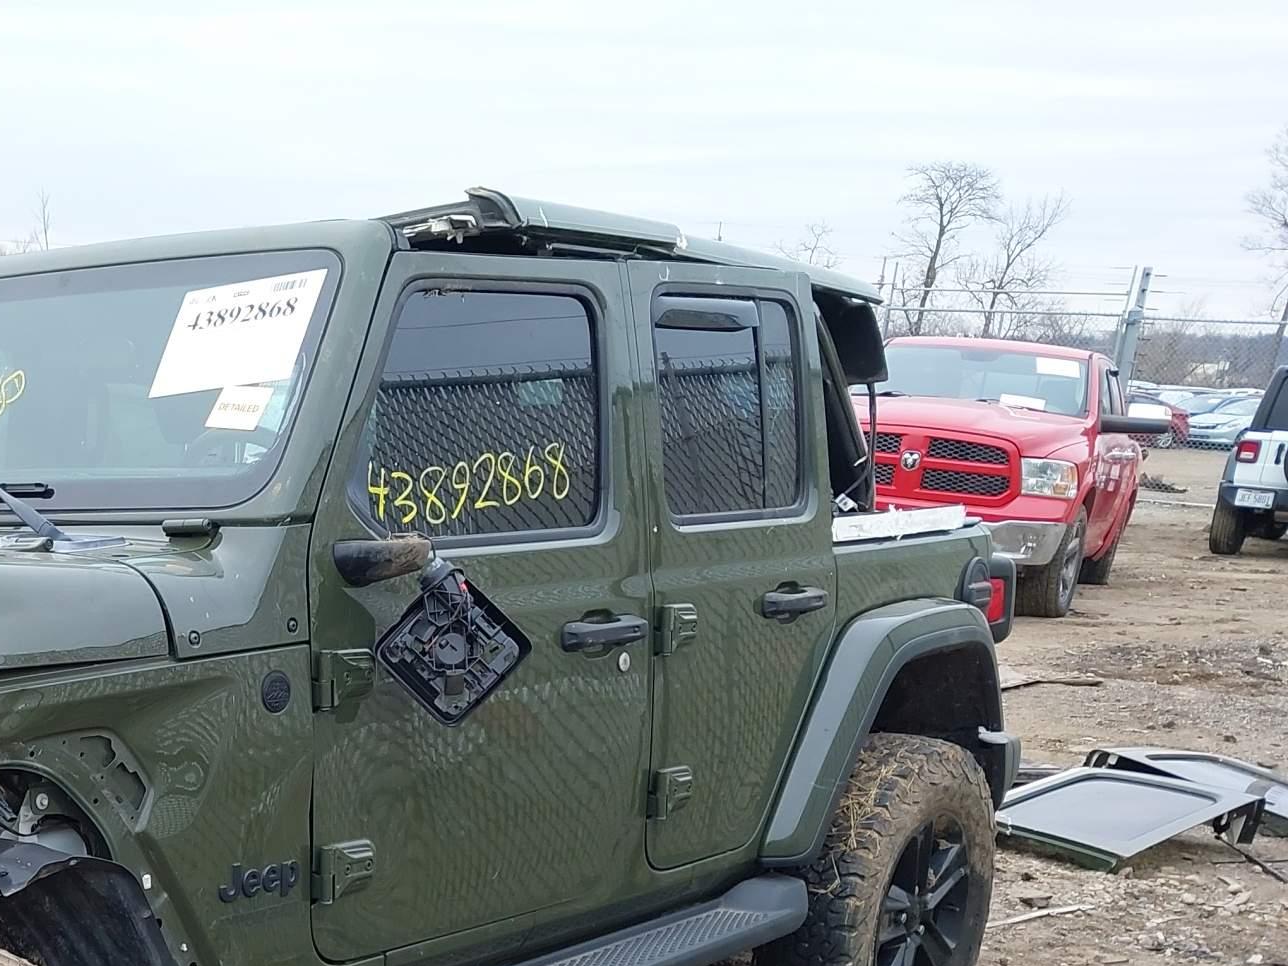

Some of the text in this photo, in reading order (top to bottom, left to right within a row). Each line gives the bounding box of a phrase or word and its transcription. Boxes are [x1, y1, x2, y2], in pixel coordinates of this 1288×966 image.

[187, 297, 298, 330] 43892868
[218, 402, 259, 414] DETAILED
[368, 442, 570, 524] 43892868
[219, 859, 298, 903] Jeep
